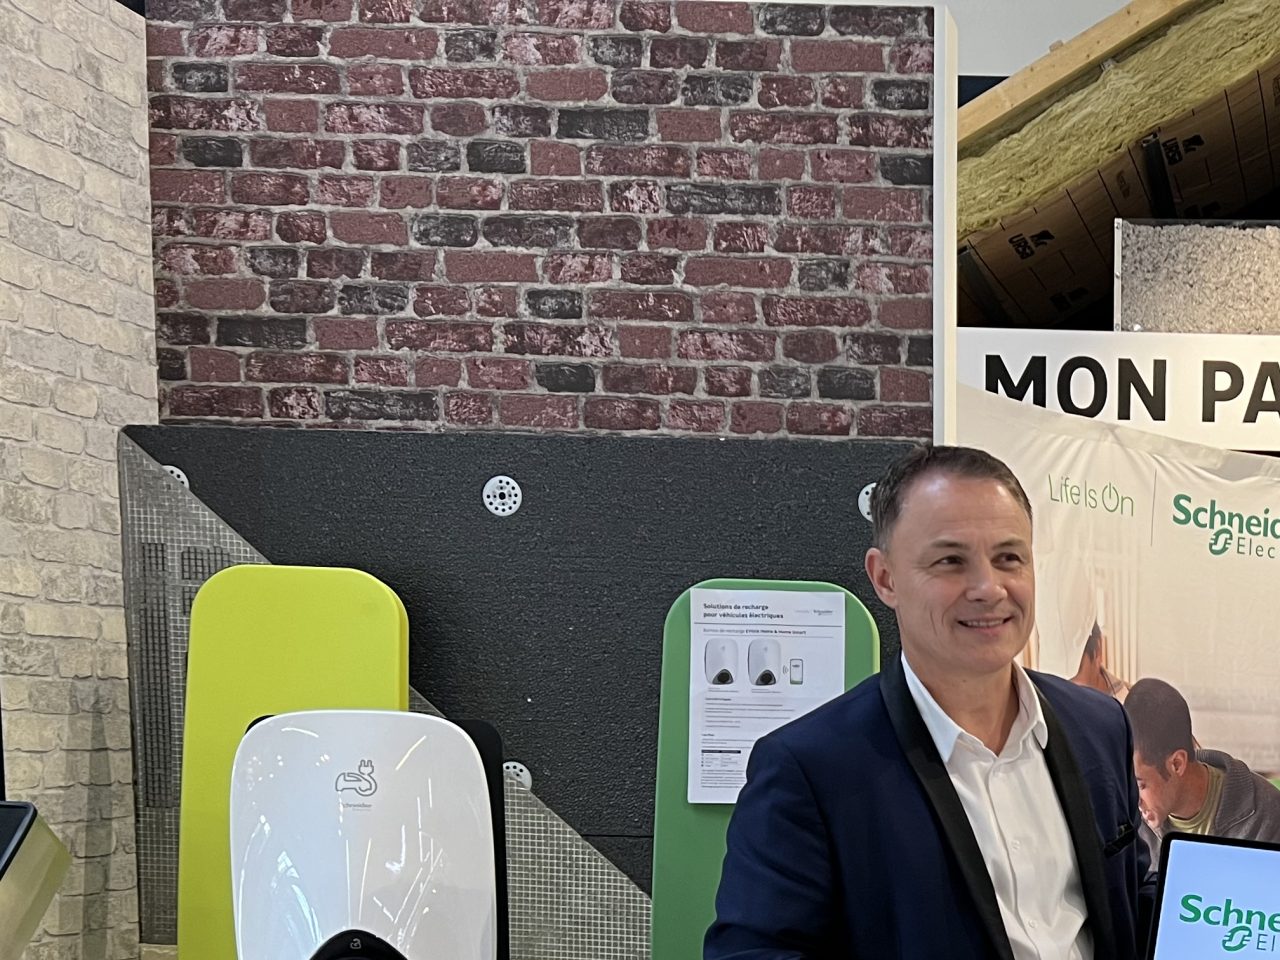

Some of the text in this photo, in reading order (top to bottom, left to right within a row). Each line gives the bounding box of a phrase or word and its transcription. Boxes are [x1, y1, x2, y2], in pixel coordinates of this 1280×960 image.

[984, 353, 1168, 422] MON
[1047, 474, 1135, 518] Life Is On
[719, 611, 748, 619] véhicules
[749, 612, 784, 620] électriques
